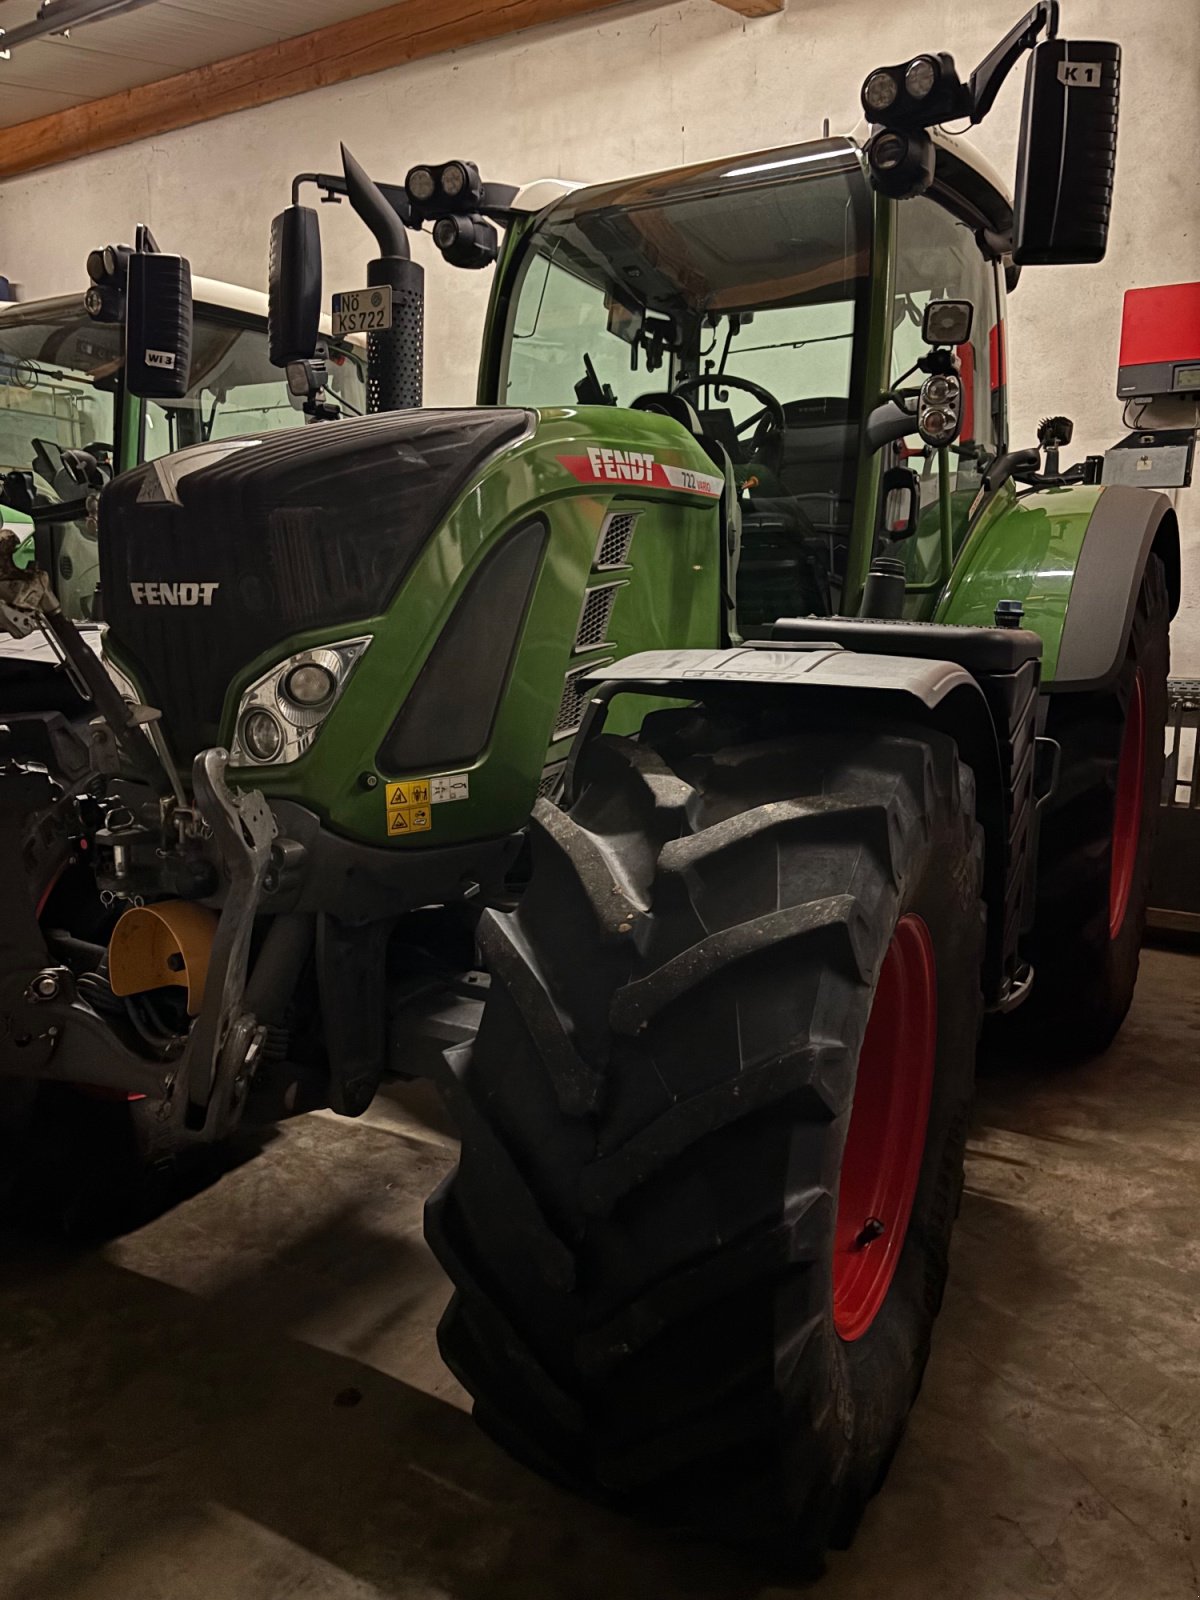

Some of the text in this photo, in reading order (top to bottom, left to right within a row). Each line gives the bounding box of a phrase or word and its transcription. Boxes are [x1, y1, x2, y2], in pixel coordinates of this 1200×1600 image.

[1065, 67, 1093, 82] K 1
[342, 293, 360, 312] NÖ
[164, 356, 173, 365] 3
[587, 447, 655, 481] FENDT
[681, 471, 696, 489] 722
[130, 582, 220, 606] FENDT
